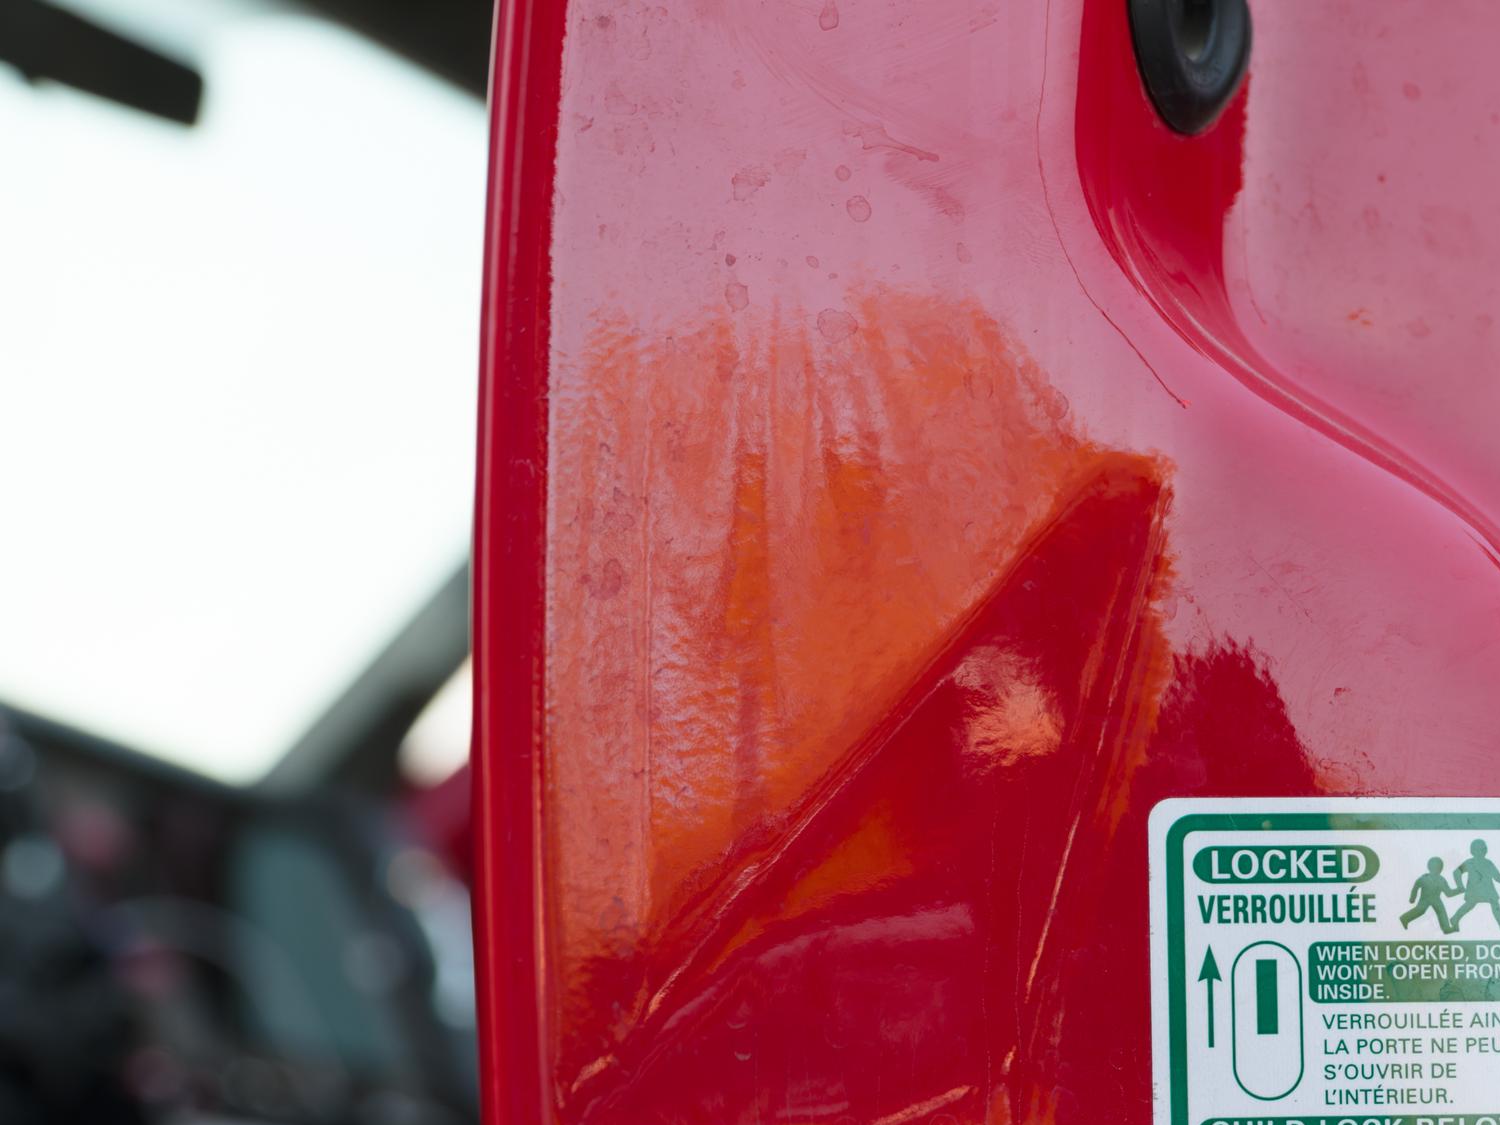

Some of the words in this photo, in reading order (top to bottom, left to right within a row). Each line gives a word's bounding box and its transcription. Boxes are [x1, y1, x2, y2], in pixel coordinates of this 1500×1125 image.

[1212, 849, 1366, 879] LOCKED
[1198, 885, 1377, 924] VERROUILLÉE
[1316, 945, 1380, 961] WHEN
[1385, 945, 1469, 963] LOCKED,
[1317, 964, 1387, 981] WON'T
[1392, 964, 1448, 980] OPEN
[1318, 983, 1390, 1000] INSIDE.
[1322, 1008, 1464, 1030] VERROUILLÉE
[1324, 1038, 1349, 1055] LA
[1356, 1038, 1423, 1055] PORTE
[1430, 1037, 1459, 1054] NE
[1324, 1063, 1423, 1081] S'OUVRIR
[1430, 1062, 1457, 1080] DE
[1325, 1084, 1454, 1106] L'INTÉRIEUR.
